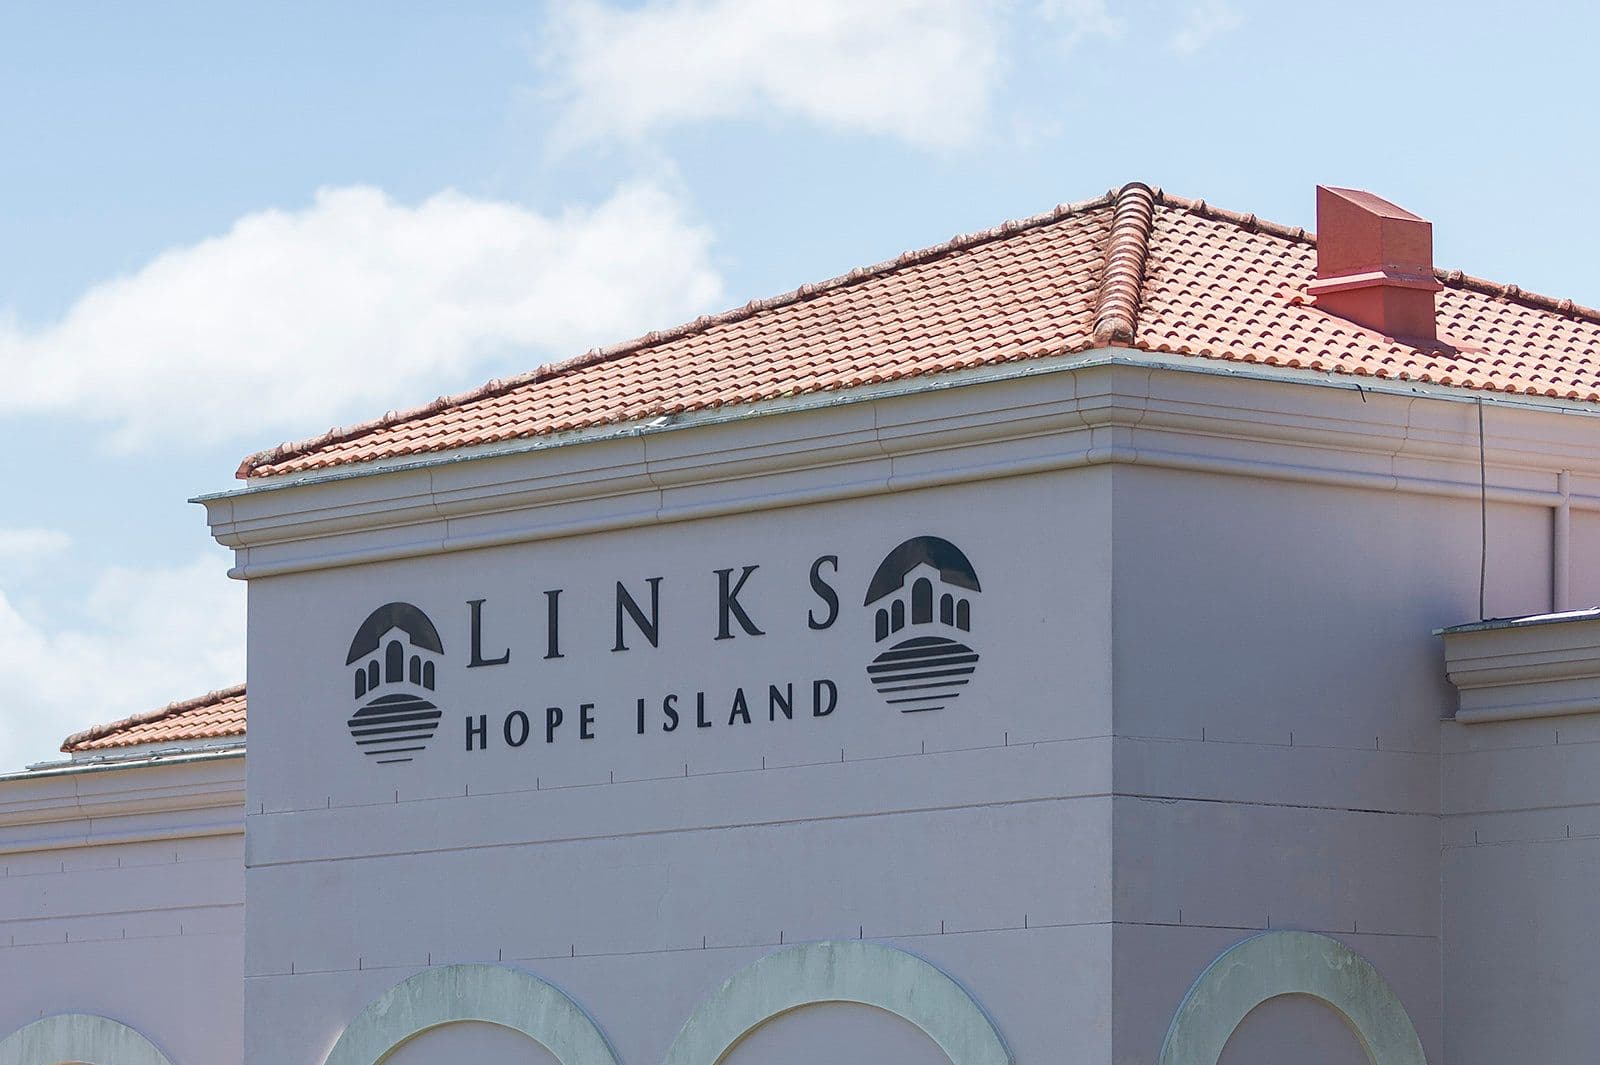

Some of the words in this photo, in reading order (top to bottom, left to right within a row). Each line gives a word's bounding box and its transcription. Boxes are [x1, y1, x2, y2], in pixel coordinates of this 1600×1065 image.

[465, 555, 840, 669] LINKS
[465, 703, 596, 751] HOPE
[636, 679, 839, 735] ISLAND
